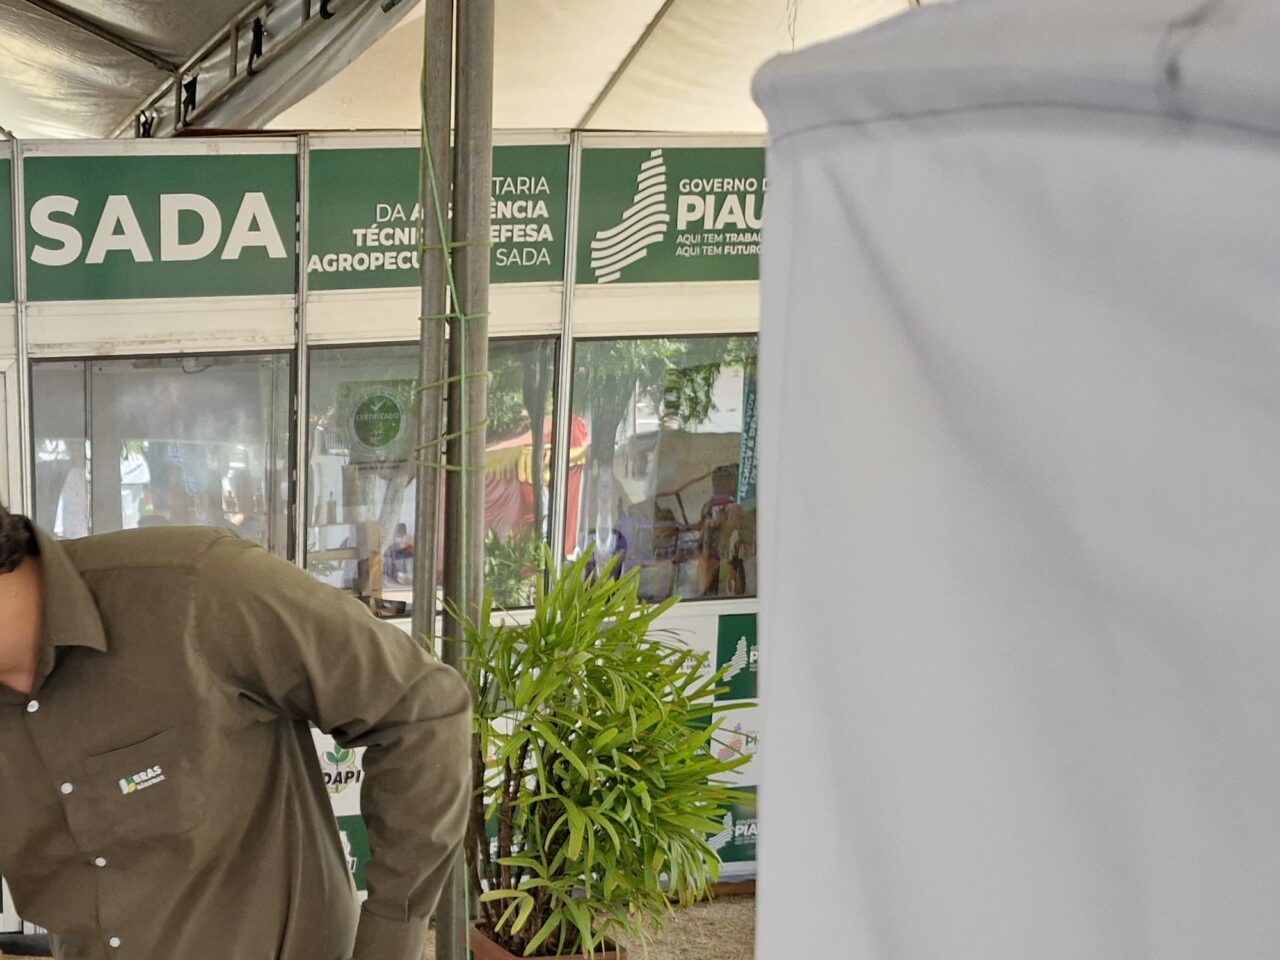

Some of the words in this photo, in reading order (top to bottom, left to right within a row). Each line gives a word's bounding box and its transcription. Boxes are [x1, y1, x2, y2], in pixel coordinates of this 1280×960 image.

[679, 178, 757, 193] GOVERNO
[376, 204, 406, 222] DA
[677, 194, 766, 230] PIAU
[30, 192, 287, 266] SADA
[353, 224, 423, 247] TÉCNI
[490, 224, 554, 243] EFESA
[676, 234, 701, 245] AQUI
[703, 233, 723, 242] TEM
[496, 248, 551, 266] SADA
[676, 247, 700, 256] AQUI
[702, 246, 722, 255] TEM
[323, 769, 361, 785] DAPI
